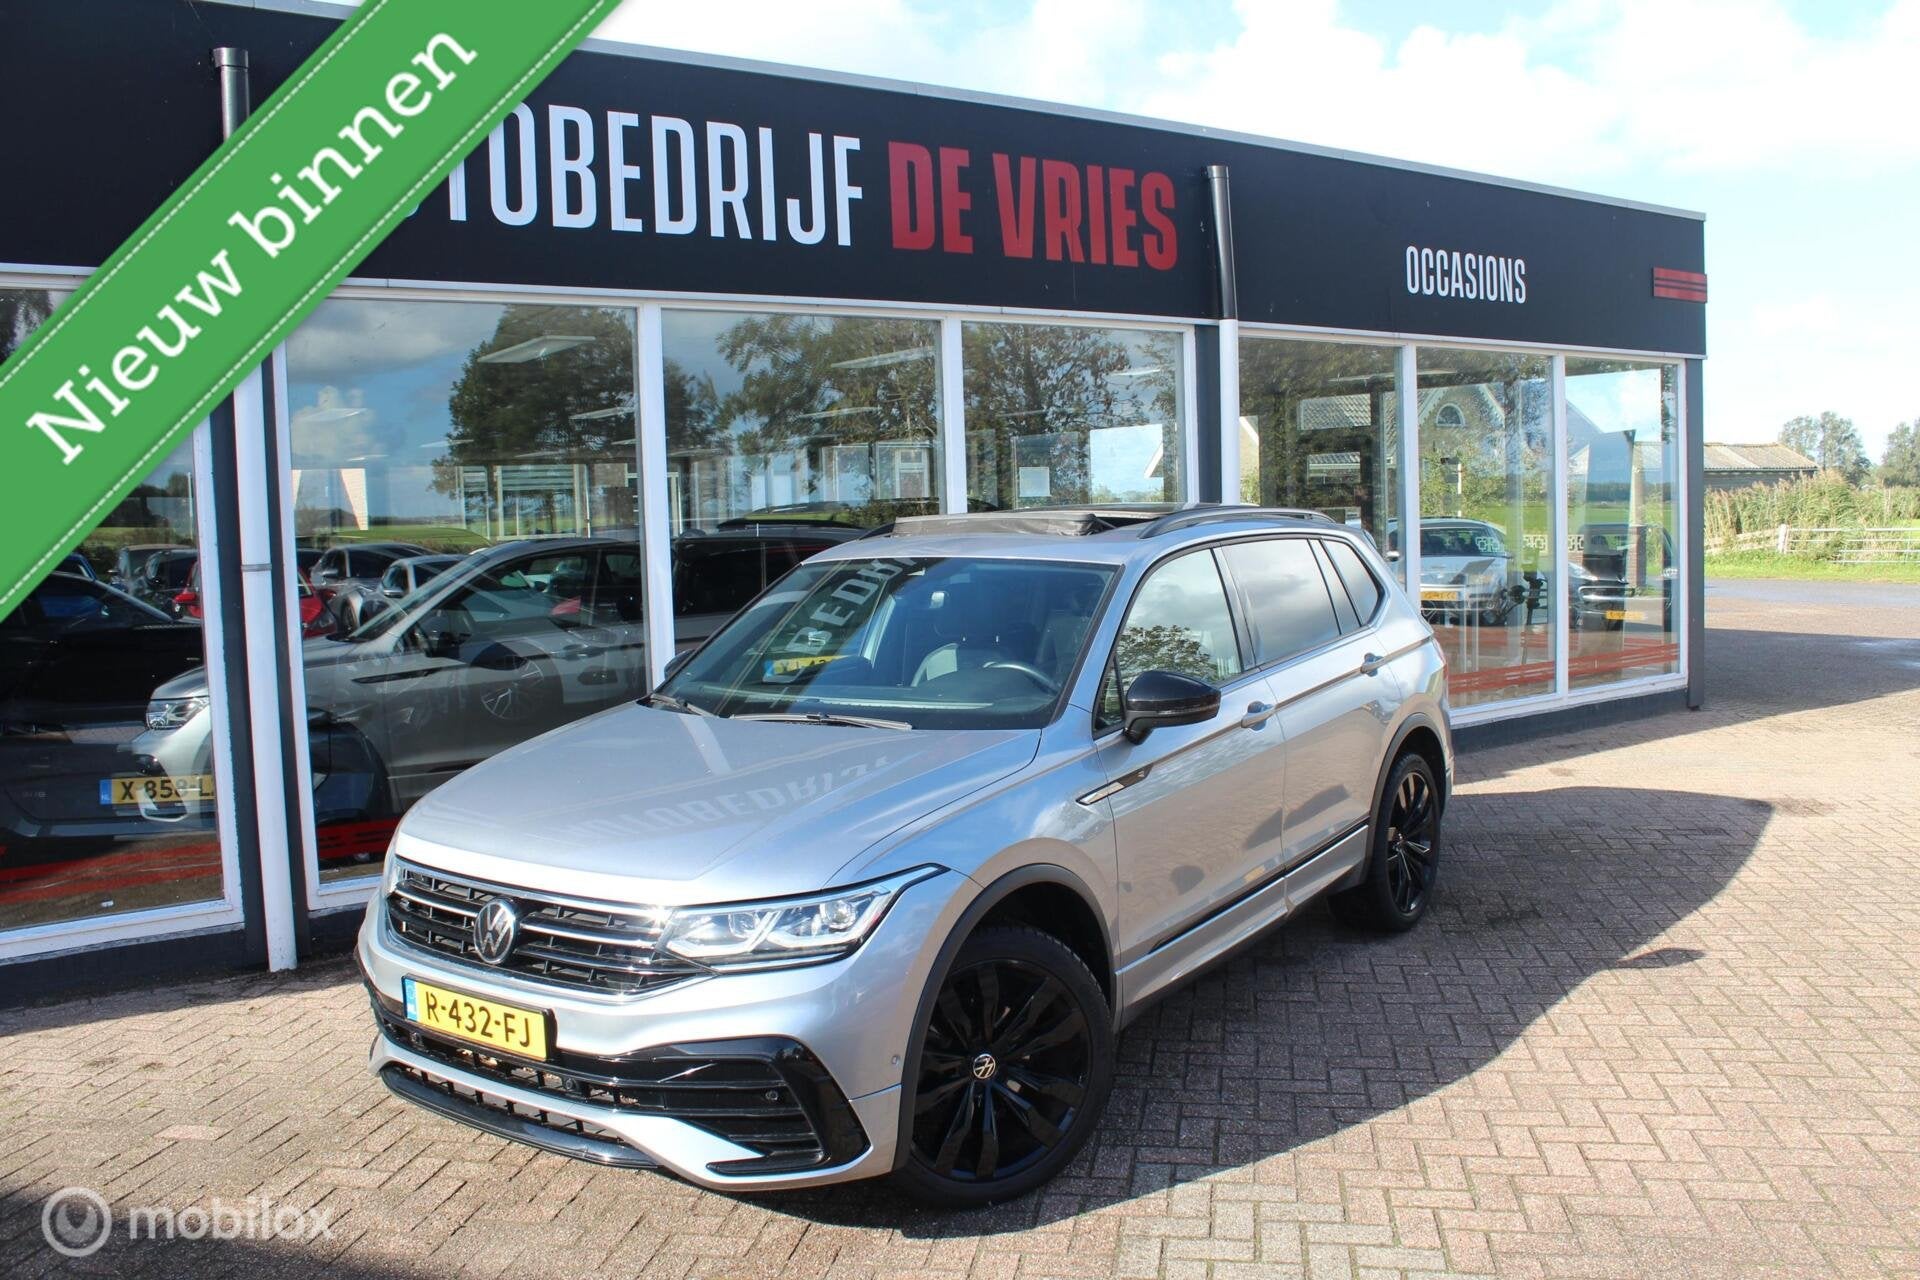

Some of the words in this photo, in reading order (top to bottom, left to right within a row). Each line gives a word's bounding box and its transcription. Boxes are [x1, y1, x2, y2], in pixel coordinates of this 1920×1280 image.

[405, 101, 863, 247] OBEDRIJF
[889, 141, 974, 254] DE
[993, 154, 1178, 270] VRIES
[1405, 245, 1527, 304] OCCASIONS
[121, 779, 215, 801] X858-L
[425, 991, 531, 1047] R-432-FJ
